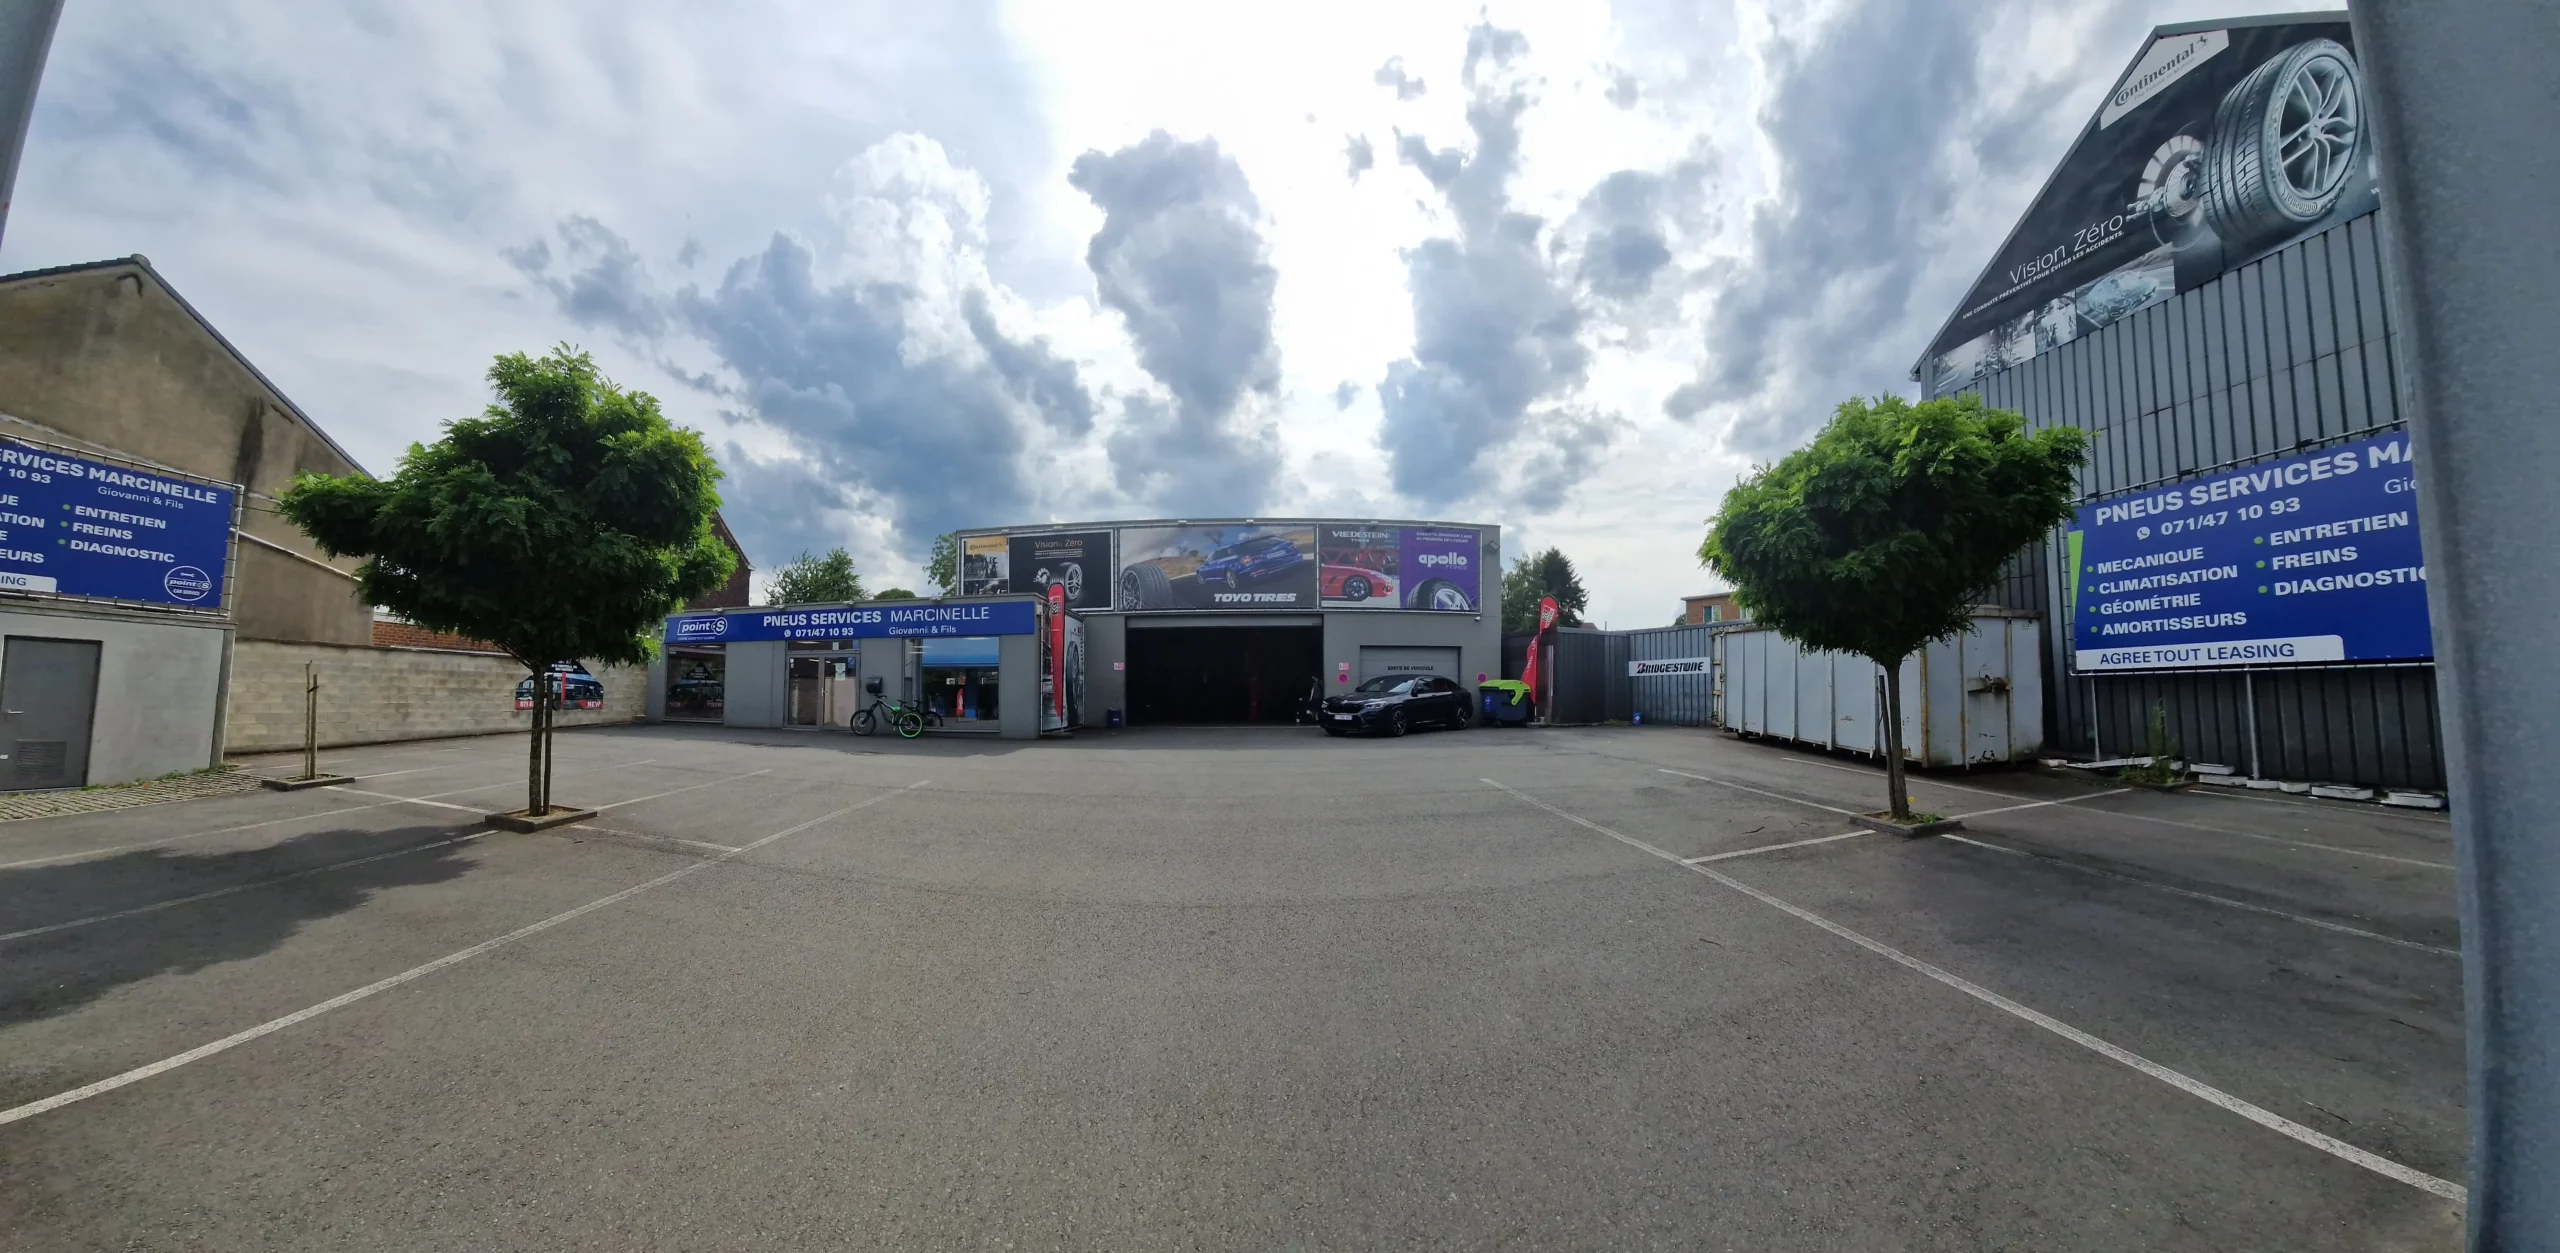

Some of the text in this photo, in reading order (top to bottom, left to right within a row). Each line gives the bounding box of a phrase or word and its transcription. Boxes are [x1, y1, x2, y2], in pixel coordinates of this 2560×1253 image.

[2114, 42, 2195, 107] Continental
[2009, 214, 2124, 285] Vision Zéro
[2033, 270, 2050, 282] POUR
[2073, 250, 2085, 261] LES
[0, 448, 217, 504] RVICES MARCINELLE
[8, 468, 27, 480] 10
[30, 472, 51, 484] 93
[98, 485, 184, 510] Giovanni & Fils
[2096, 491, 2183, 526] PNEUS
[2189, 451, 2359, 506] SERVICES
[75, 505, 166, 529] ENTRETIEN
[2161, 498, 2301, 536] 071/47 10 93
[2270, 510, 2408, 546] ENTRETIEN
[72, 522, 133, 540] FREINS
[70, 539, 175, 563] DIAGNOSTIC
[1034, 540, 1058, 549] Vision
[1418, 551, 1468, 568] apollo
[2098, 546, 2204, 575] MECANIQUE
[2272, 546, 2358, 570] FREINS
[2099, 564, 2238, 595] CLIMATISATION
[1214, 592, 1297, 602] TOYO TIRES
[2100, 592, 2201, 616] GÉOMÉTRIE
[681, 621, 711, 633] point
[763, 606, 990, 627] PNEUS SERVICES MARCINELLE
[2102, 611, 2247, 636] AMORTISSEURS
[795, 627, 854, 638] 071/47 10 93
[889, 625, 957, 635] Giovanni & Fils
[2100, 643, 2295, 666] AGREE TOUT LEASING
[1636, 661, 1704, 674] BRIDGESTONE
